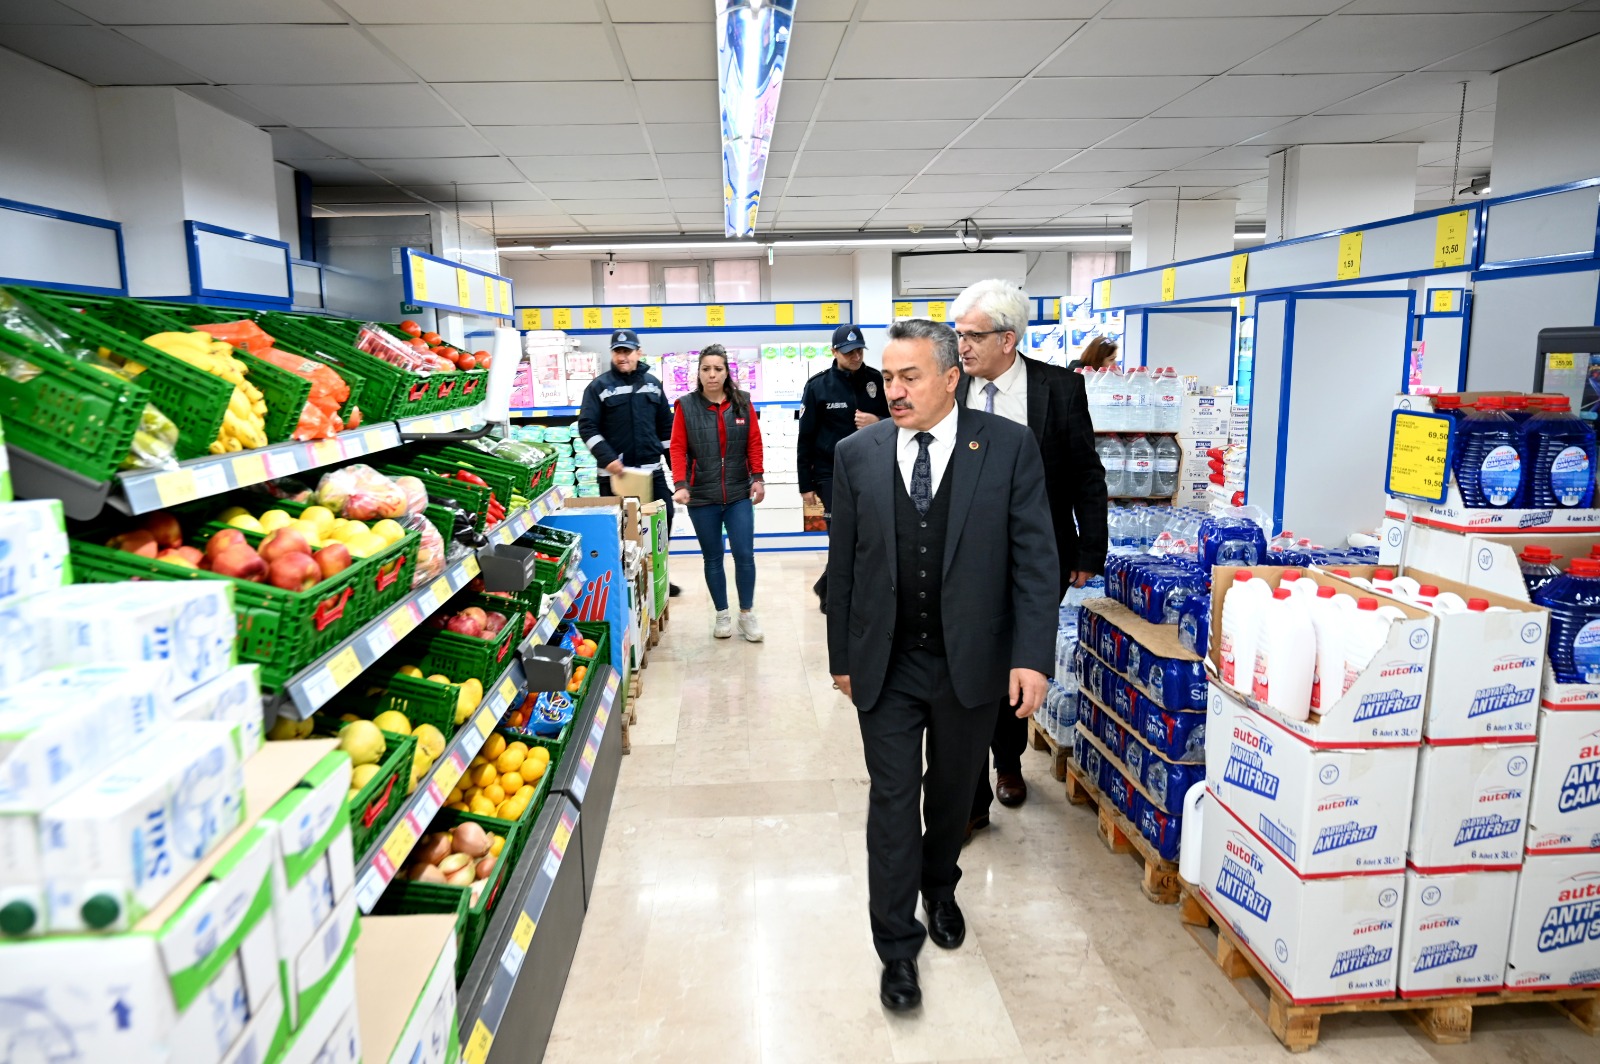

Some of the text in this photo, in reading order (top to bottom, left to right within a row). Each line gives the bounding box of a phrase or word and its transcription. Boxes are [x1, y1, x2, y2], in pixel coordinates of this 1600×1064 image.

[1442, 244, 1459, 254] 13,50
[1428, 432, 1448, 440] 69,50
[1426, 456, 1446, 464] 44,50
[1424, 478, 1442, 487] 19,50
[1469, 514, 1502, 526] autofix
[1380, 664, 1424, 677] autofix
[1493, 658, 1536, 672] autofix
[1560, 692, 1599, 703] autofix
[1372, 728, 1378, 736] 6
[1486, 723, 1491, 731] 6
[1233, 727, 1274, 756] autofix
[1230, 742, 1263, 768] RADYATÖR
[1479, 790, 1522, 803] autofix
[1317, 798, 1359, 812] autofix
[1536, 834, 1572, 848] autofix
[1226, 840, 1264, 874] autofix
[1356, 858, 1361, 866] 6
[1222, 856, 1255, 889] RADYATÖR
[1352, 922, 1393, 936] autofix
[1419, 918, 1460, 931] autofix
[1538, 921, 1586, 950] CAM
[1515, 973, 1550, 986] autofix
